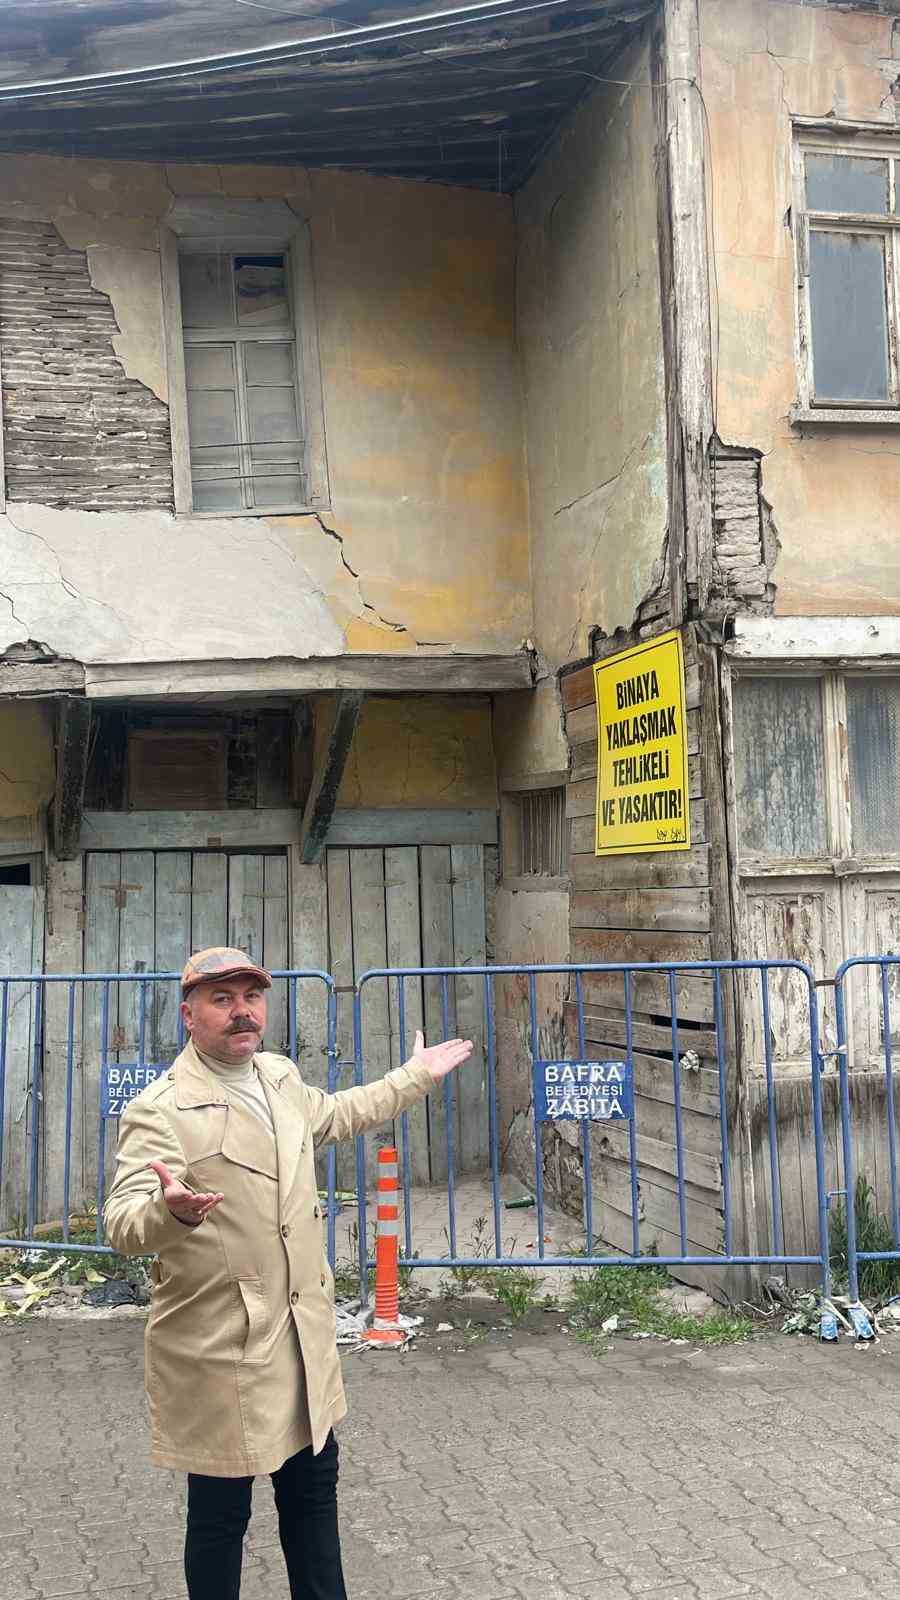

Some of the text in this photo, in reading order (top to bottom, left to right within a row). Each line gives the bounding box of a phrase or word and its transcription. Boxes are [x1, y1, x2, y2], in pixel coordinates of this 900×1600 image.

[616, 670, 659, 710] BİNAYA
[606, 706, 677, 751] YAKLAŞMAK
[612, 750, 670, 787] TEHLİKELİ
[602, 789, 682, 826] VE YASAKTIR!
[107, 1069, 158, 1084] BAFR
[545, 1065, 622, 1082] BAFRA
[109, 1087, 144, 1097] BELED
[545, 1083, 623, 1096] BELEDİYESİ
[546, 1099, 624, 1115] ZABITA
